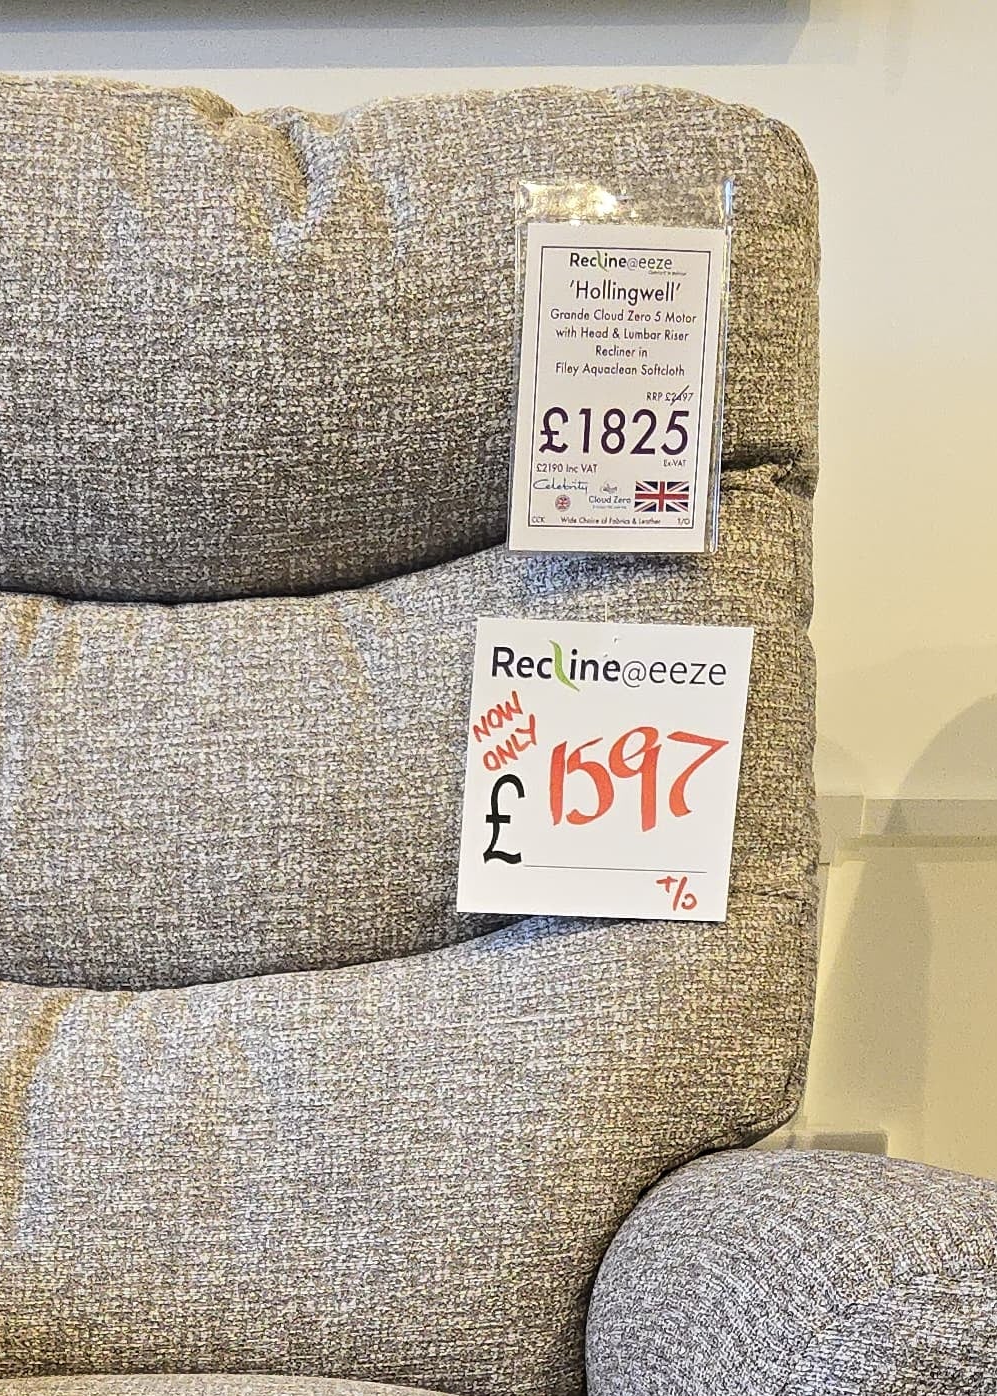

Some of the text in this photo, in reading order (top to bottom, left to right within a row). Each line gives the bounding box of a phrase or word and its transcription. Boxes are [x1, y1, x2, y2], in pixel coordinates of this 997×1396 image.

[550, 308, 697, 323] Grande Cloud Zero 5 Motor
[556, 326, 690, 341] with Head & Lumbar Riser
[595, 345, 648, 358] Recliner in
[555, 362, 685, 376] Filey Aquaclean Softcloth
[646, 391, 663, 401] RRP
[538, 406, 690, 456] £1825
[536, 463, 598, 473] £2190 Inc VAT
[532, 477, 588, 495] Celebrity
[589, 496, 632, 504] Cloud Zero
[491, 639, 727, 692] Recline@eeze
[472, 690, 524, 742] NOW
[482, 713, 538, 772] ONLY
[483, 726, 730, 865] £ 1597
